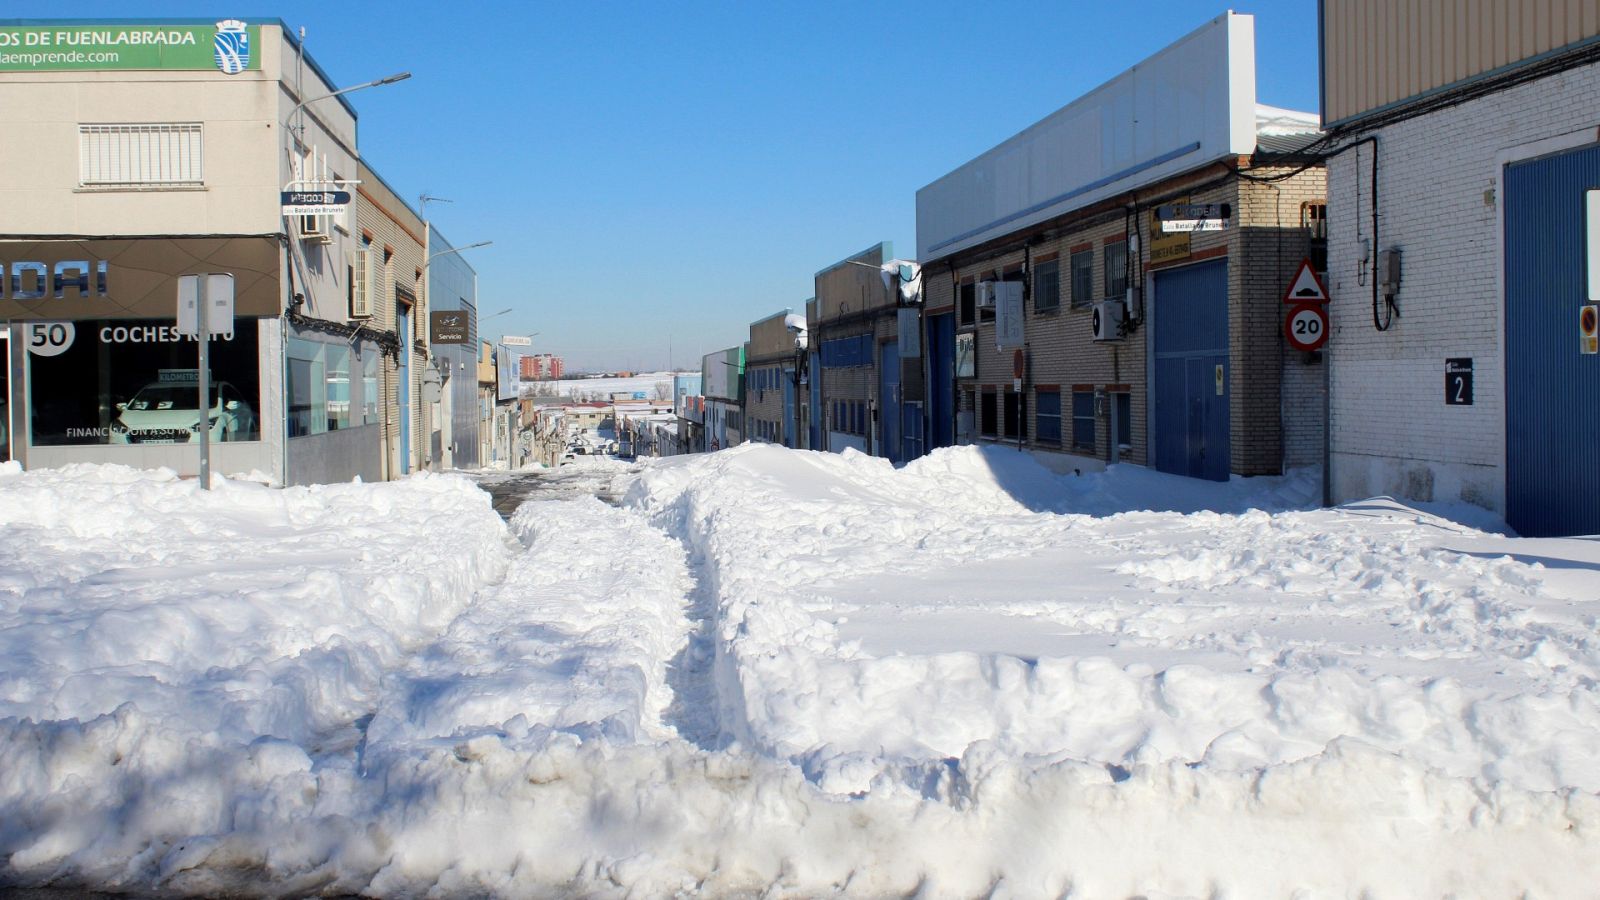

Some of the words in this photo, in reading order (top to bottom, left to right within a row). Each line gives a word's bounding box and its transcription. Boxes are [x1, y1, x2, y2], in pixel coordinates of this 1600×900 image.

[25, 32, 50, 46] DE
[56, 31, 196, 45] FUENLABRADA
[0, 51, 119, 66] aemprende.com
[0, 260, 107, 299] DAI
[31, 323, 67, 347] 50
[100, 326, 181, 343] COCHES
[1295, 319, 1320, 335] 20
[1455, 376, 1464, 402] 2
